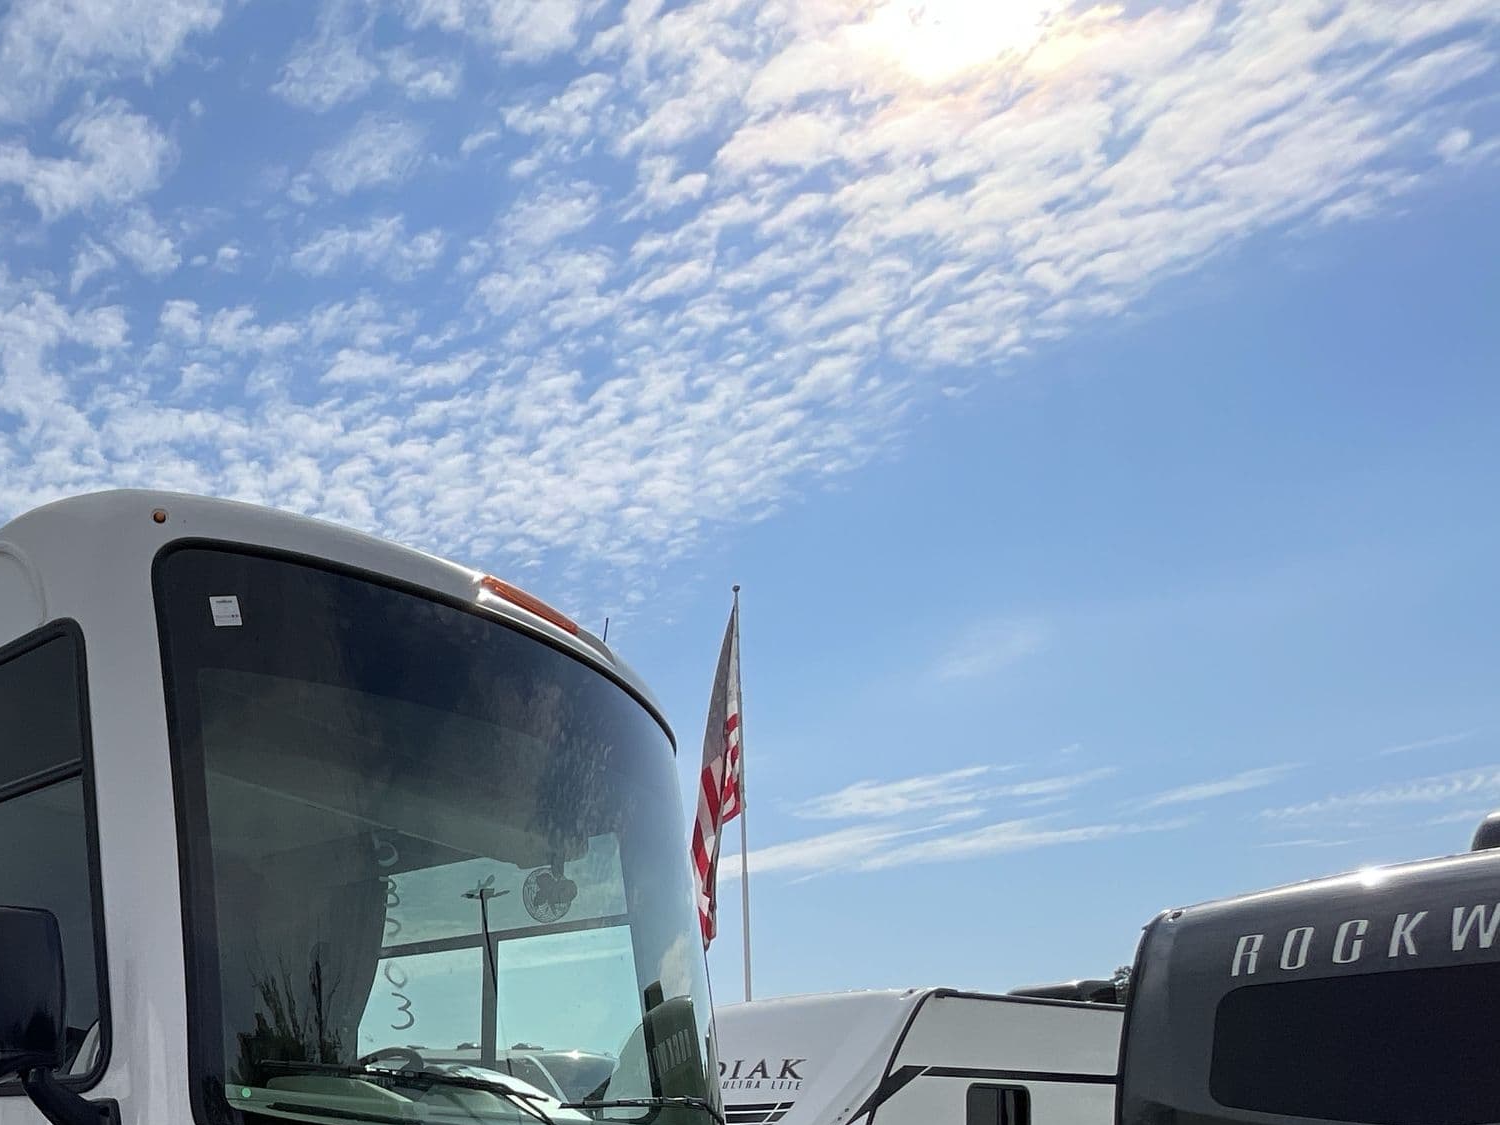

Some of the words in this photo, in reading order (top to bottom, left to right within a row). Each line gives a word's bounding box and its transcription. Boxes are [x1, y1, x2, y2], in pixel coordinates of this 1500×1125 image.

[1231, 902, 1500, 977] ROCKW
[722, 1081, 761, 1090] ULTRA
[771, 1081, 803, 1091] LITE
